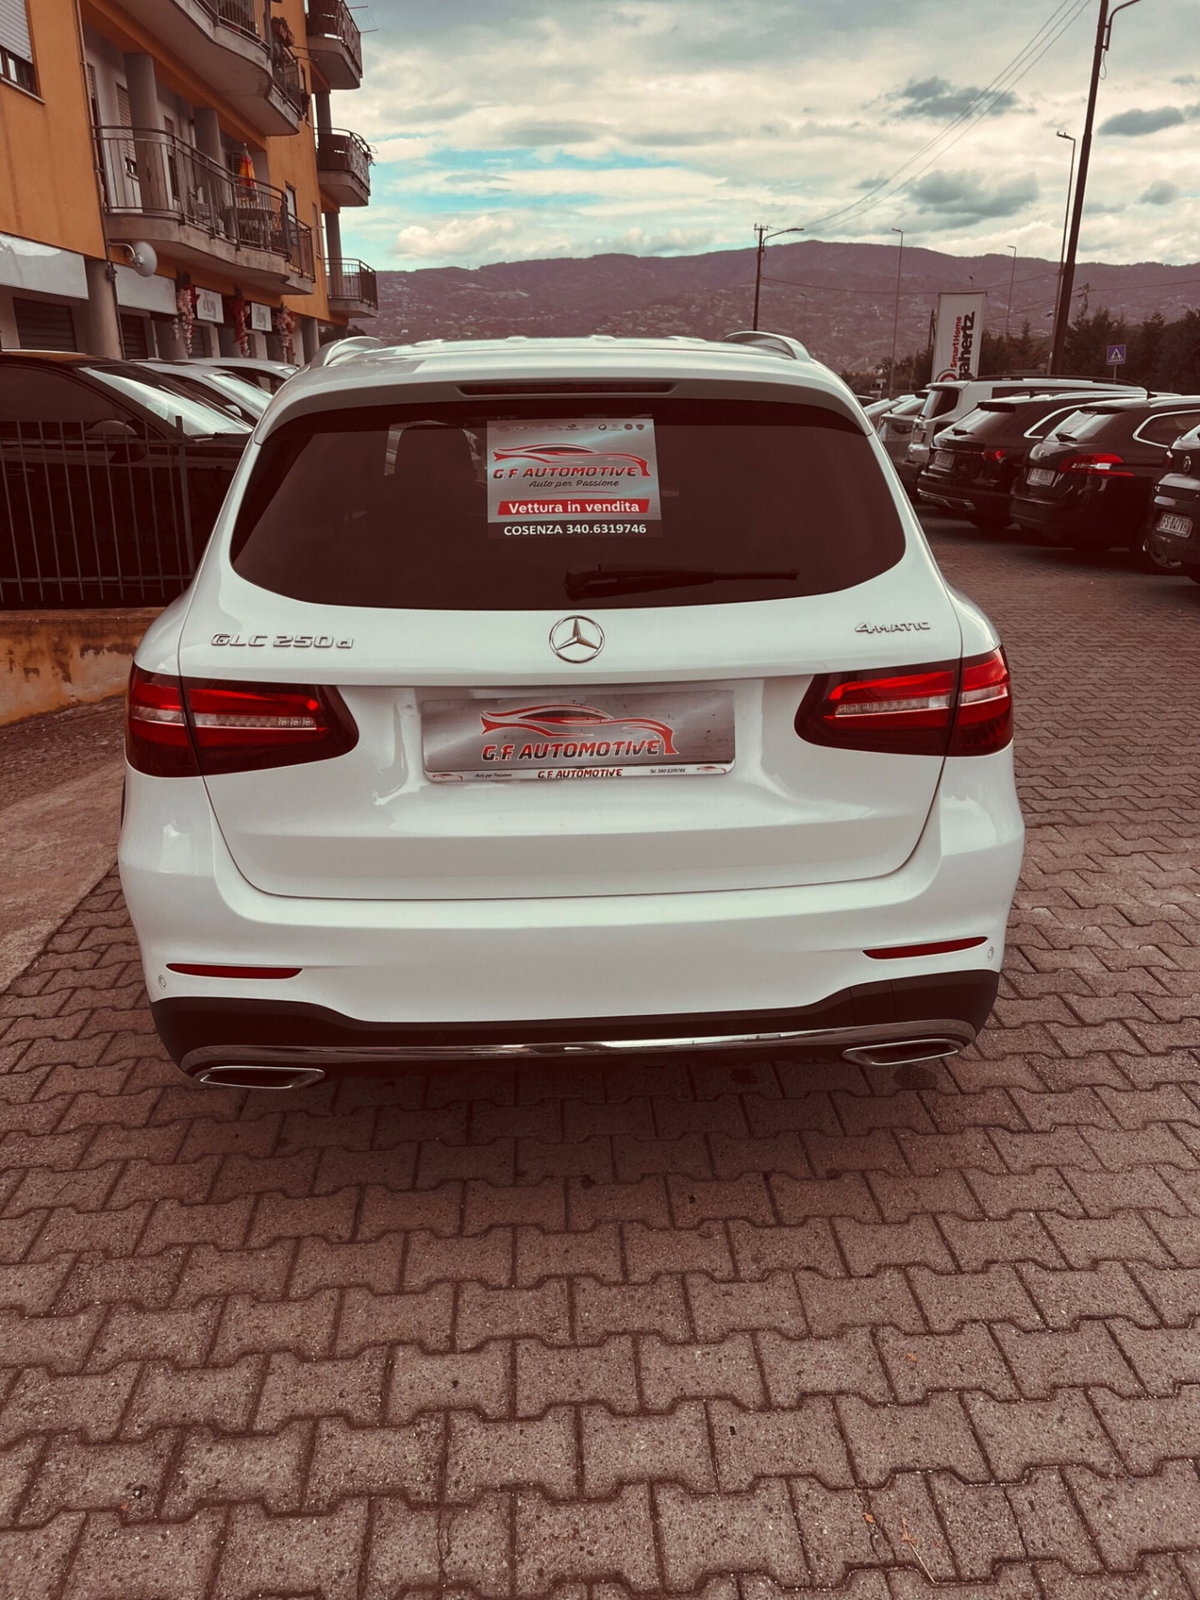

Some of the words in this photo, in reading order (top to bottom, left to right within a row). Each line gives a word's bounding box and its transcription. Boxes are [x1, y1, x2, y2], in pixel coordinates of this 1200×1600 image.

[522, 466, 638, 478] AUTOMOTIVE
[529, 480, 553, 488] Auto
[554, 480, 573, 489] per
[575, 479, 619, 487] Passione
[508, 502, 563, 514] Vettura
[567, 501, 581, 513] in
[585, 501, 640, 513] vendita
[504, 525, 562, 536] COSENZA
[566, 523, 647, 534] 340.6319746
[855, 622, 931, 634] 4MATIC
[211, 633, 268, 647] GLC
[518, 739, 662, 761] AUTOMOTIVE
[555, 769, 623, 778] AUTOMOTIVE
